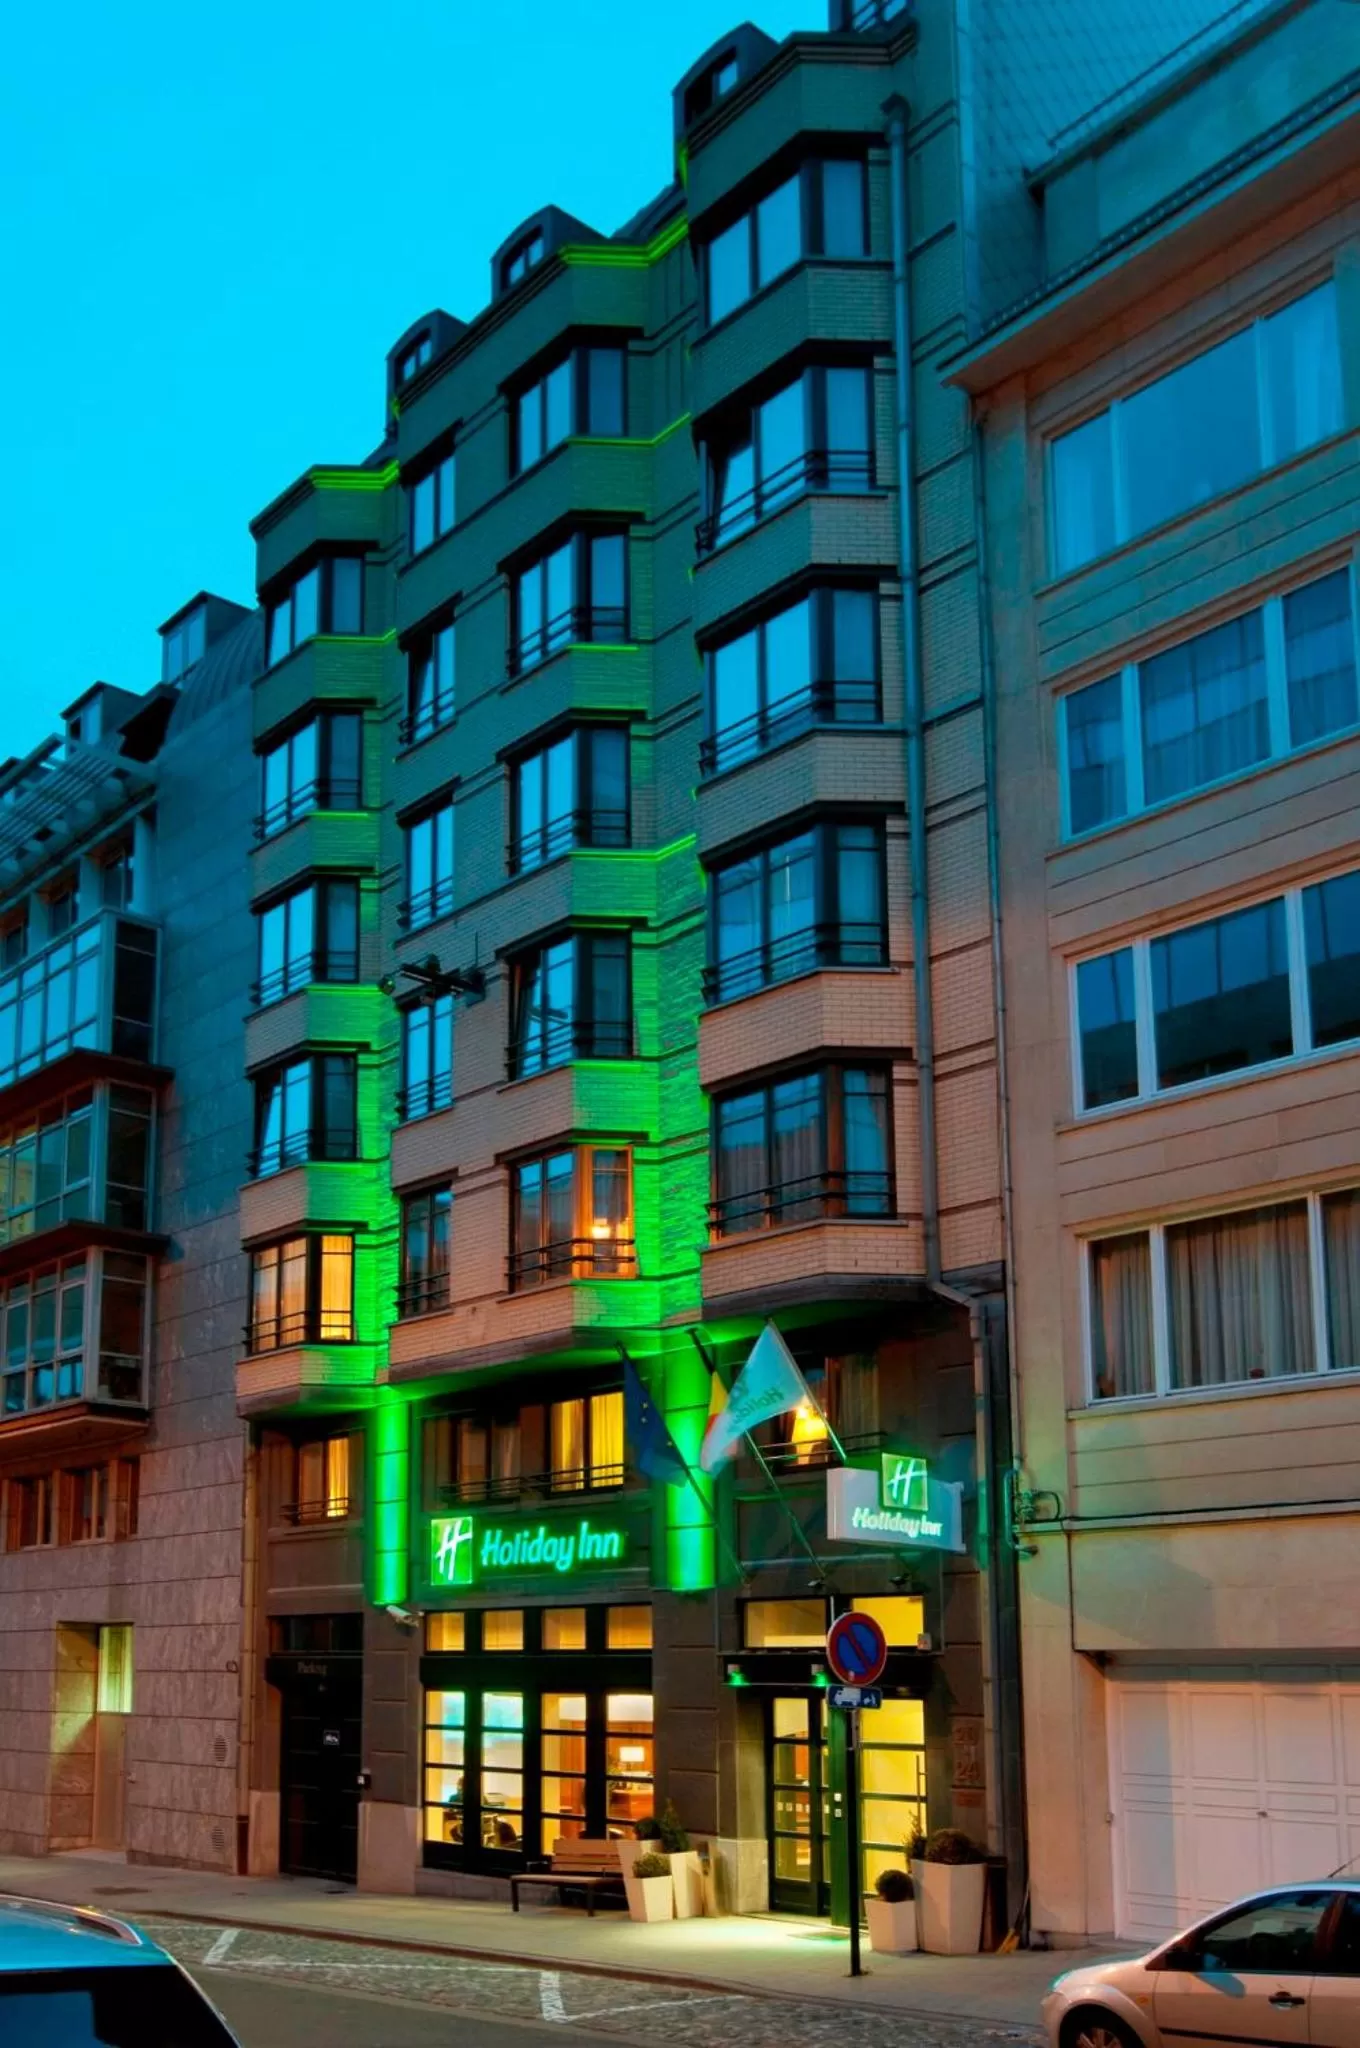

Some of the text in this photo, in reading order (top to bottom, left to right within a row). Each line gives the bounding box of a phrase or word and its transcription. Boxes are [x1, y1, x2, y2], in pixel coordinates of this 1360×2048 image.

[852, 1507, 943, 1538] Holiday Inn
[480, 1521, 620, 1571] Holiday Inn
